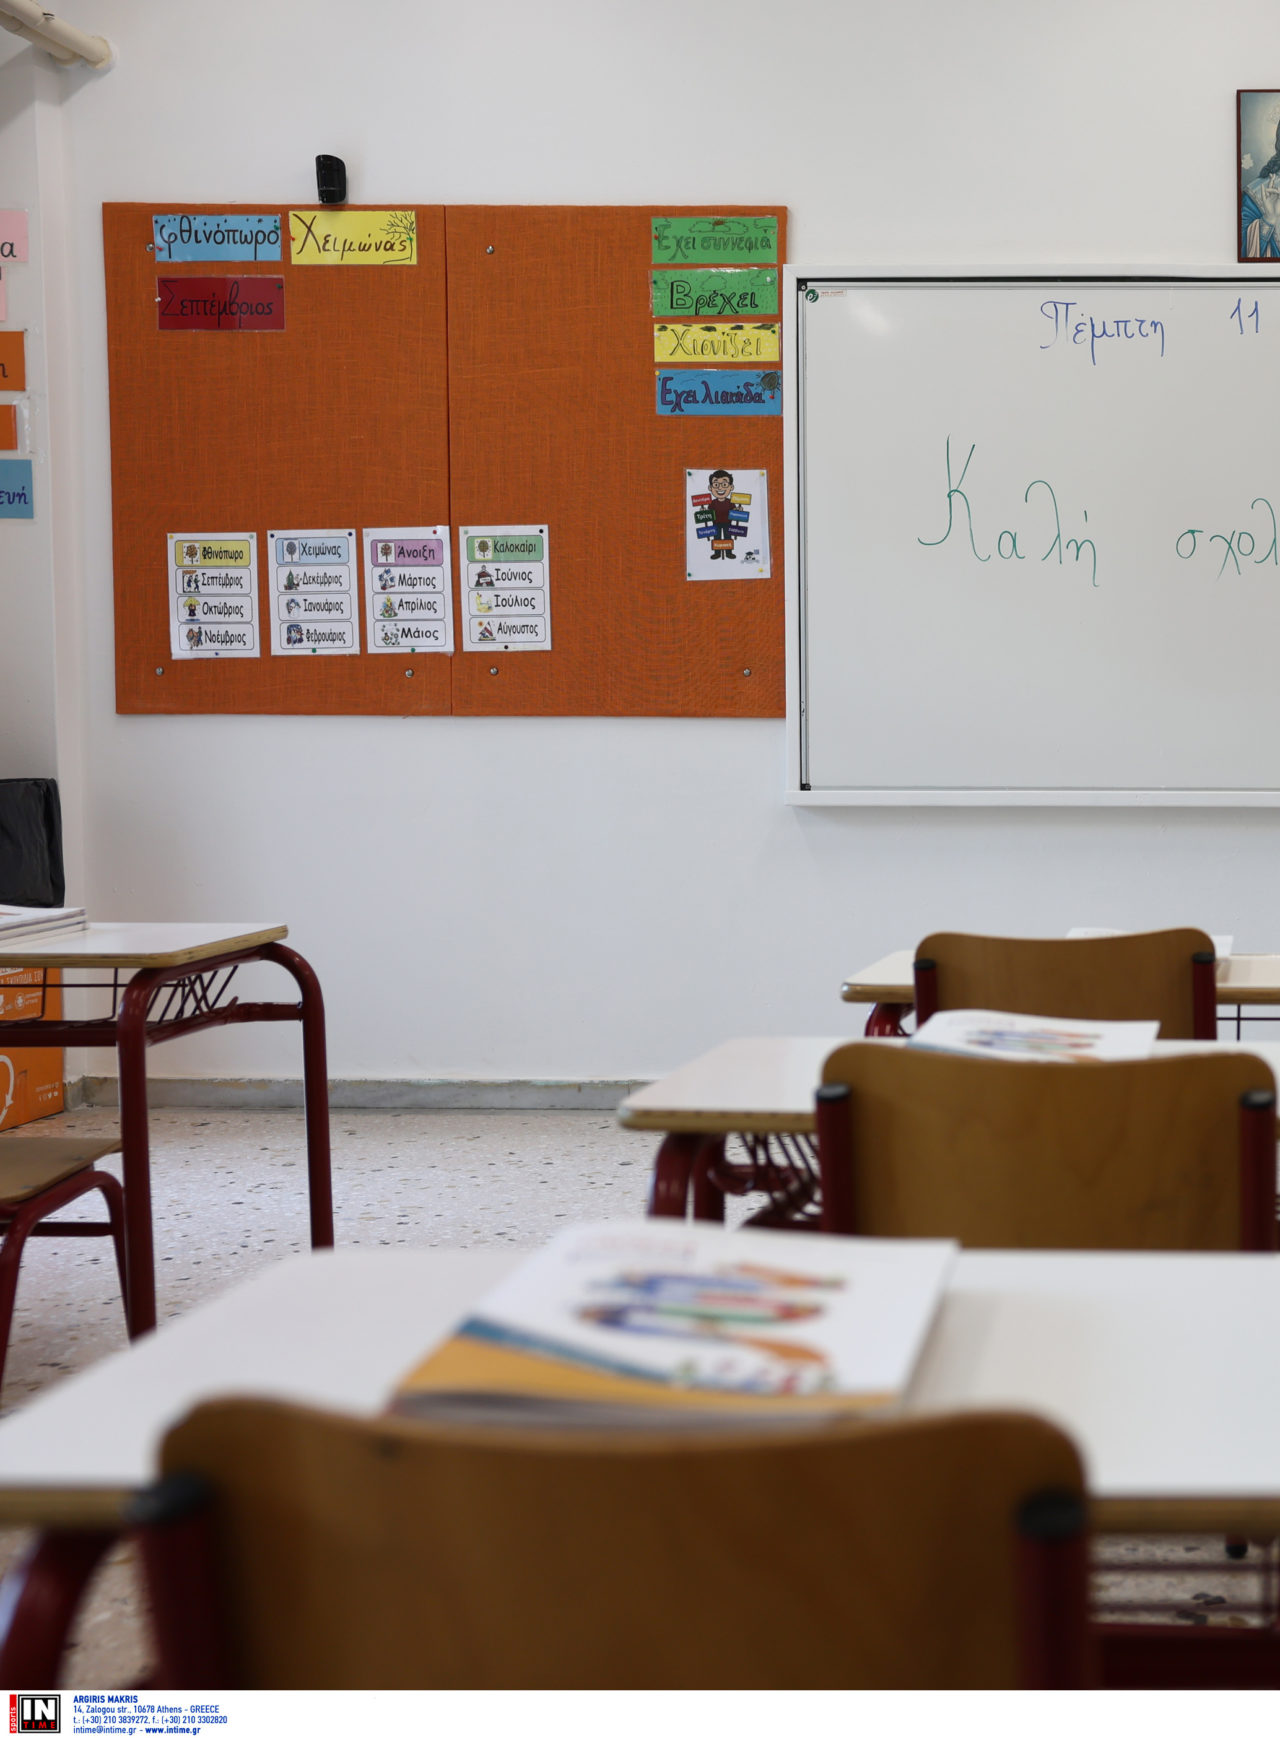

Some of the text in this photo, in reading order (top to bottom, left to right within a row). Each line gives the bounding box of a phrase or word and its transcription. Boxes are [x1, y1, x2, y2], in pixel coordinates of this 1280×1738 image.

[292, 213, 407, 262] Χειμώνας
[161, 280, 274, 328] Σεπτέμβριος
[670, 279, 759, 316] Βρέχει
[1040, 300, 1165, 366] Πέμπτη
[1230, 297, 1260, 335] 11
[669, 328, 762, 358] Χιονίζει
[917, 433, 1100, 588] Καλή
[202, 547, 244, 562] Φθινόπωρο
[301, 542, 342, 558] Χειμώνας
[397, 545, 435, 560] Άνοιξη
[493, 540, 536, 554] Καλοκαίρι
[201, 573, 243, 589] Σεπτέμβριος
[302, 572, 343, 588] Δεκέμβριος
[398, 574, 436, 589] Μάρτιος
[494, 568, 533, 583] Ιούνιος
[202, 601, 244, 618] Οκτώβριος
[303, 599, 344, 614] Ιανουάριος
[397, 598, 437, 614] Απρίλιος
[494, 594, 536, 610] Ιούλιος
[204, 629, 247, 646] Νοέμβριος
[305, 629, 346, 645] Φεβρουάριος
[400, 626, 439, 641] Μάιος
[497, 622, 538, 637] Αύγουστος
